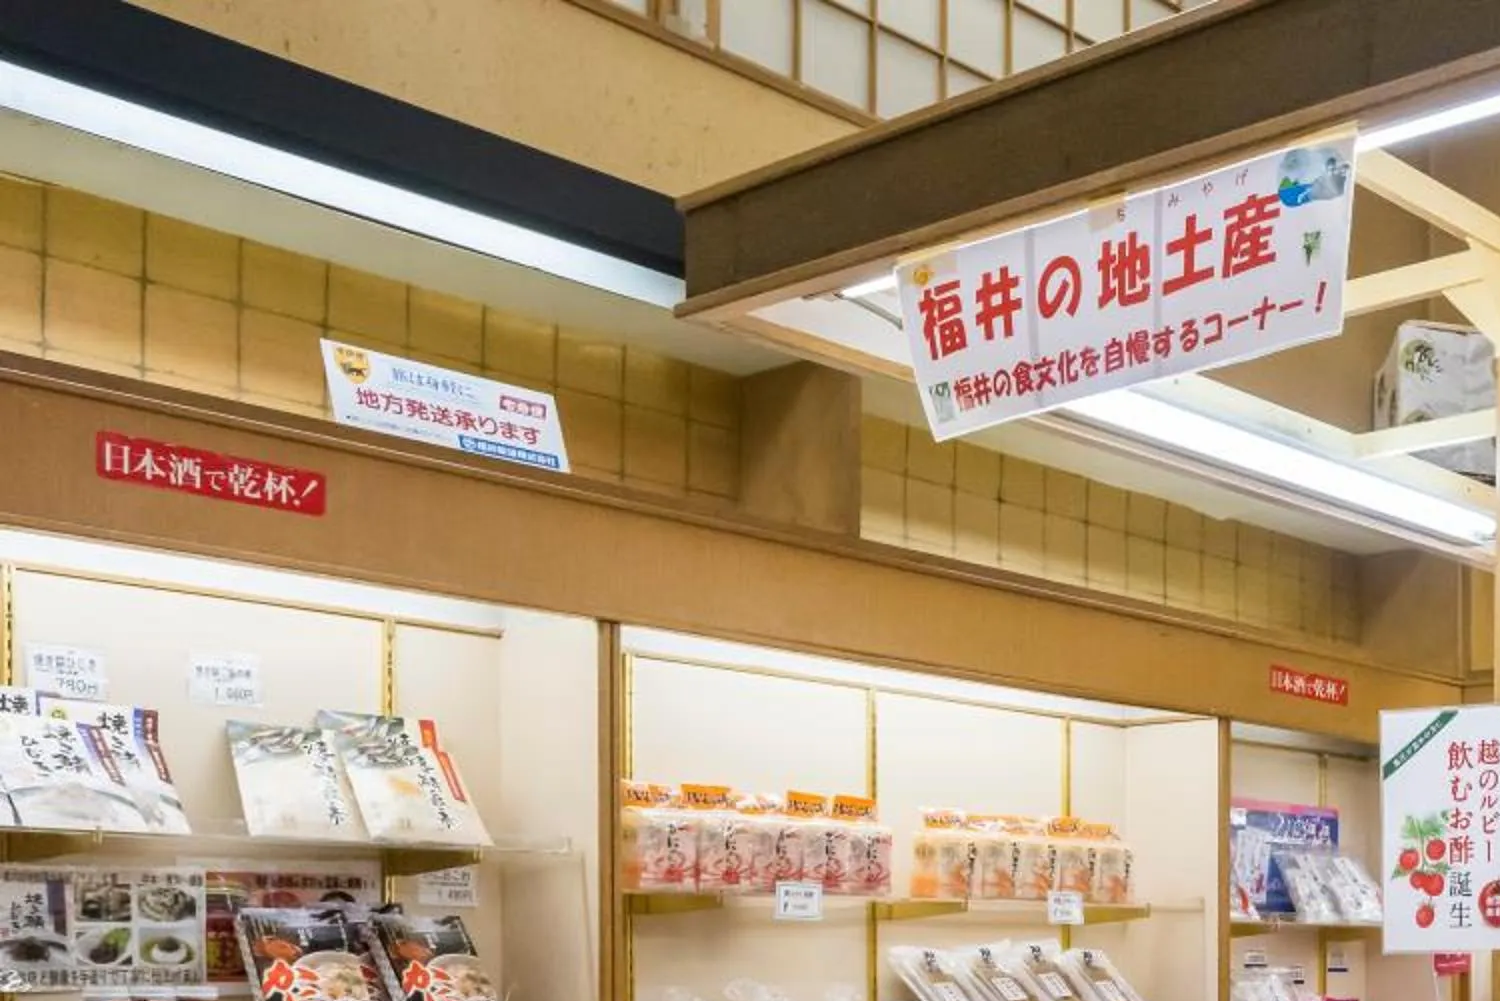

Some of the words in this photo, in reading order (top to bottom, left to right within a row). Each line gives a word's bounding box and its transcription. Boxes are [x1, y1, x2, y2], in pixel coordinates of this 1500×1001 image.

[919, 193, 1282, 362] 福井の地土産
[102, 441, 320, 507] 日本酒で乾杯!
[356, 387, 541, 445] 地方発送承ります
[1447, 740, 1474, 929] 飲むお酢誕生
[1478, 739, 1500, 863] 越のルビー
